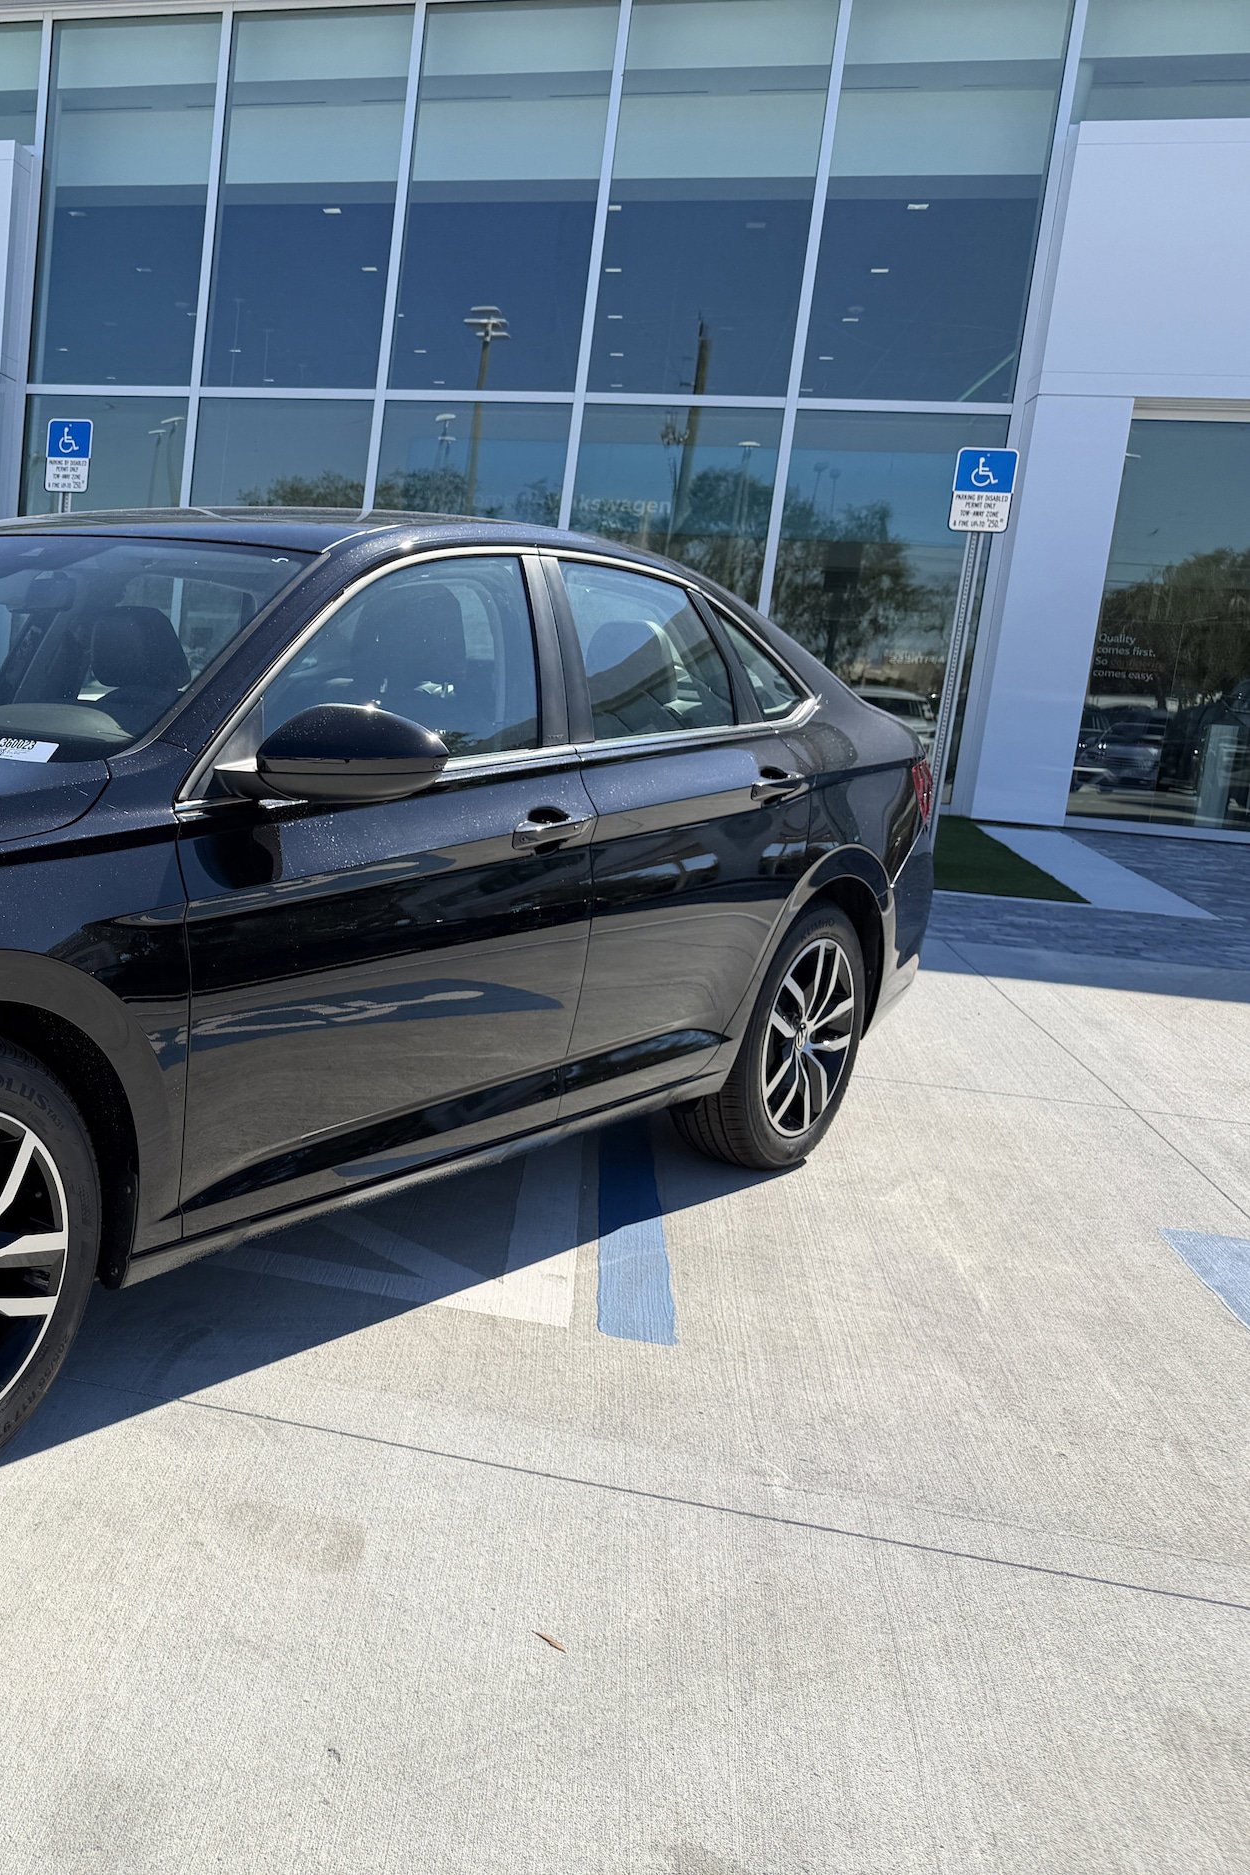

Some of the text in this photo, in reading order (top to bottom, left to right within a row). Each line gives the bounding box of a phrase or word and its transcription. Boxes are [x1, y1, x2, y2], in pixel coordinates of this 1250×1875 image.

[1098, 633, 1136, 646] Quality
[1097, 646, 1156, 657] comes first.
[1095, 656, 1108, 666] So
[1092, 669, 1154, 682] comes easy.
[0, 738, 36, 750] 360023
